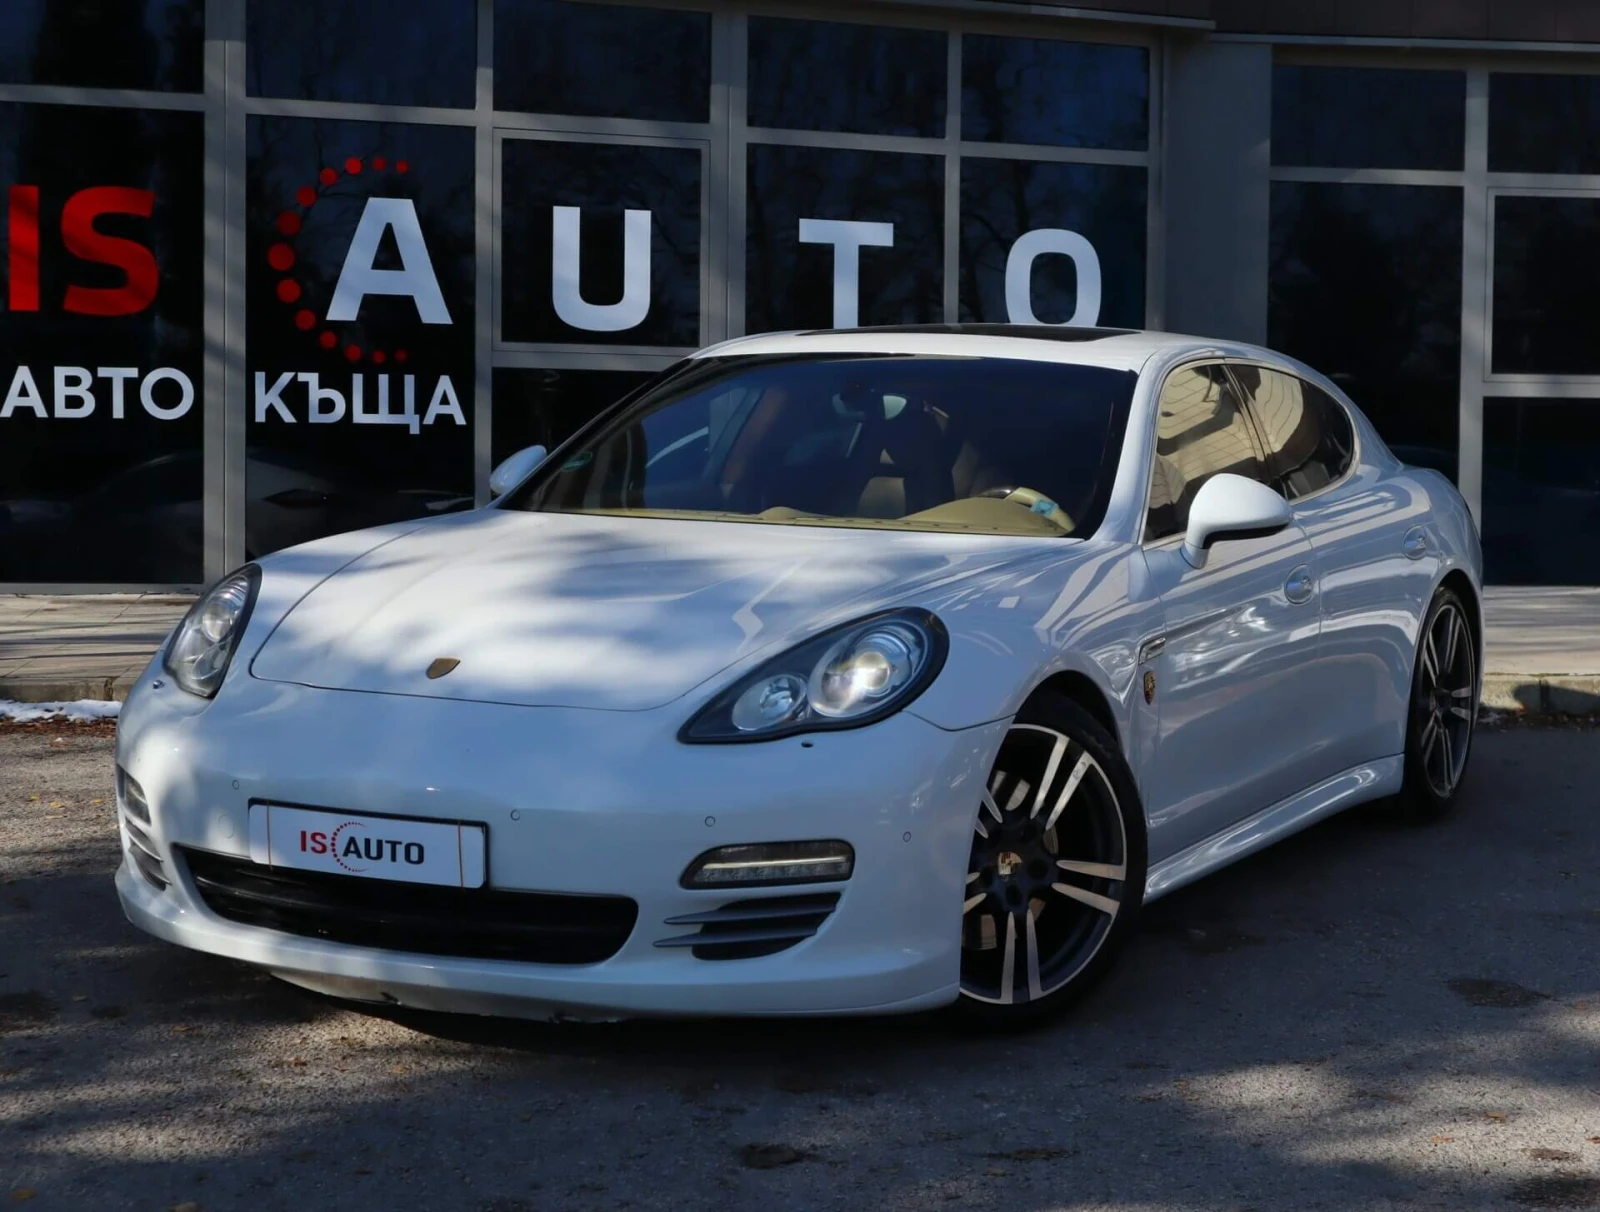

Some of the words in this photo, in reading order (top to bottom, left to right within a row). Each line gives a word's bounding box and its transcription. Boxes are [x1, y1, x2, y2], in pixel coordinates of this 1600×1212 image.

[8, 184, 160, 317] IS
[325, 196, 1102, 332] AUTO
[0, 365, 195, 421] АВТО
[254, 370, 468, 435] КЪЩА
[300, 830, 328, 855] IS
[342, 836, 425, 865] AUTO
